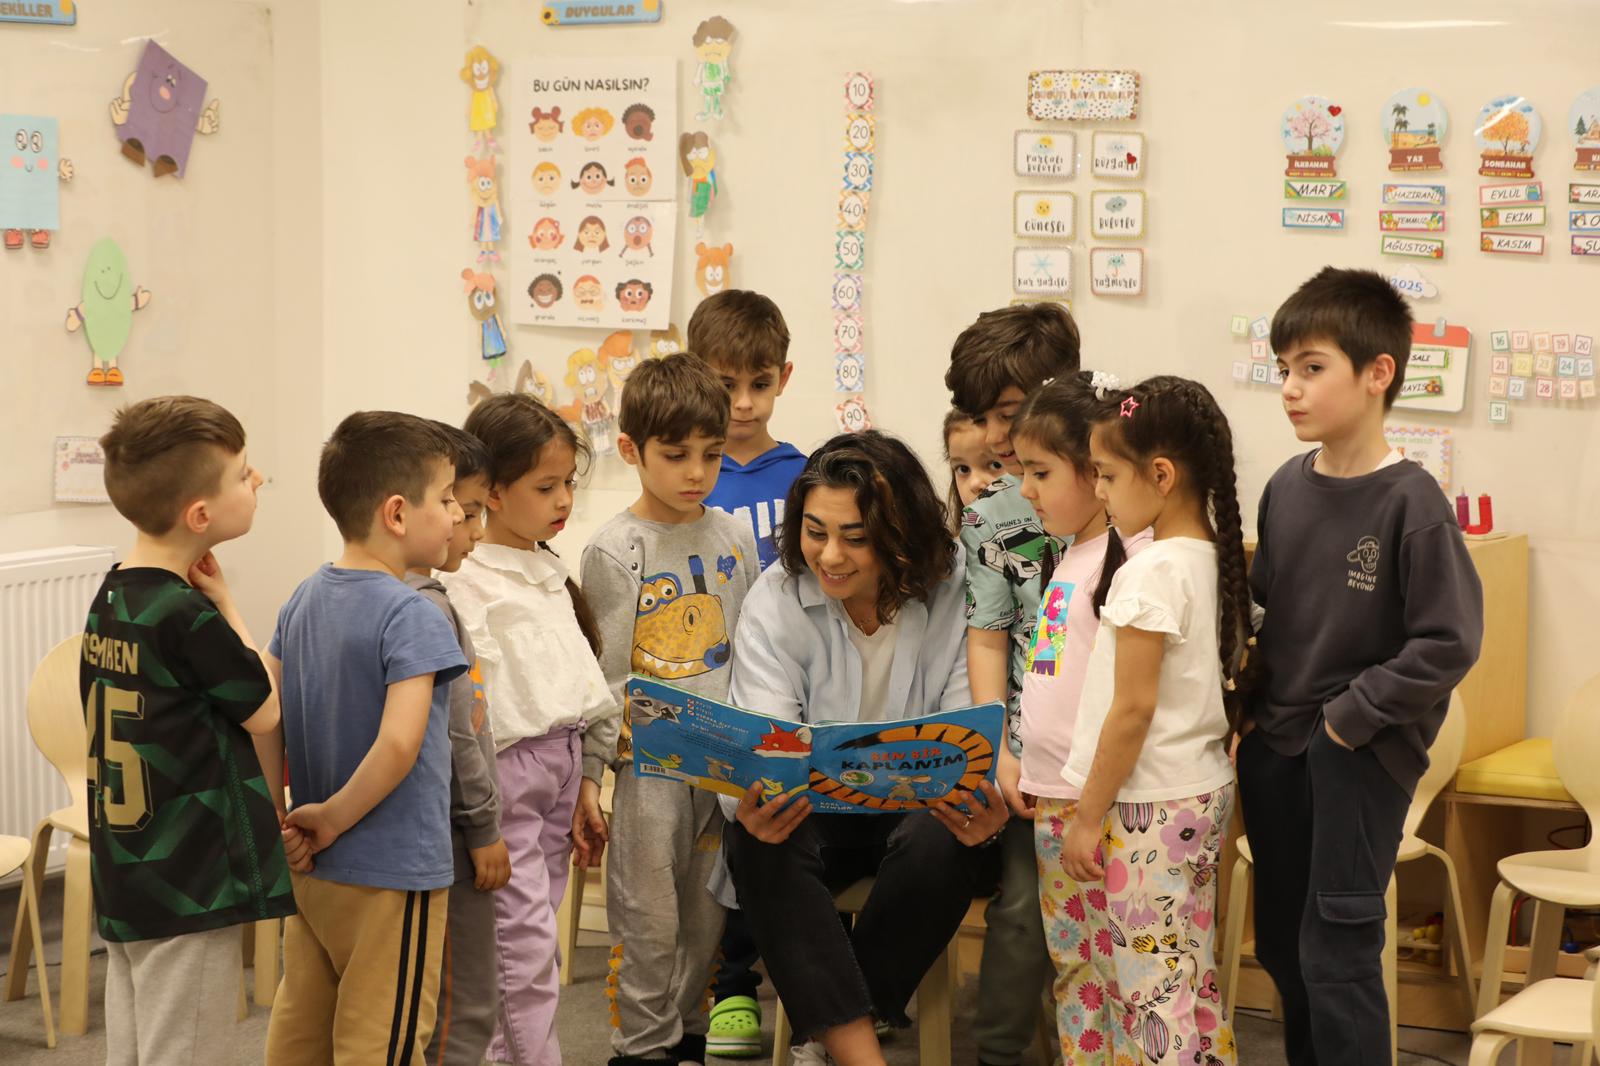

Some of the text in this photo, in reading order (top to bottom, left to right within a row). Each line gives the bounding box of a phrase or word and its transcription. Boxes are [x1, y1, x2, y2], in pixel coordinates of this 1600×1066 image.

[533, 76, 650, 92] BU GÜN NASILSIN?
[853, 83, 866, 97] 10
[853, 125, 868, 139] 20
[851, 164, 867, 178] 30
[1299, 183, 1337, 196] MART
[844, 203, 862, 217] 40
[842, 242, 859, 256] 50
[1385, 240, 1435, 254] AĞUSTOS
[1497, 239, 1532, 249] KASIM
[1392, 277, 1423, 293] 2025
[838, 286, 854, 300] 60
[841, 325, 856, 339] 70
[1577, 340, 1589, 351] 20
[1411, 353, 1432, 362] SALI
[842, 365, 858, 379] 80
[1561, 360, 1572, 370] 24
[1256, 367, 1265, 378] 12
[1540, 383, 1551, 393] 28
[846, 408, 862, 425] 90
[1348, 569, 1377, 584] IMAGINE
[1347, 578, 1375, 592] BEYOND
[841, 753, 964, 771] KAPLANIM
[871, 751, 906, 761] BEN
